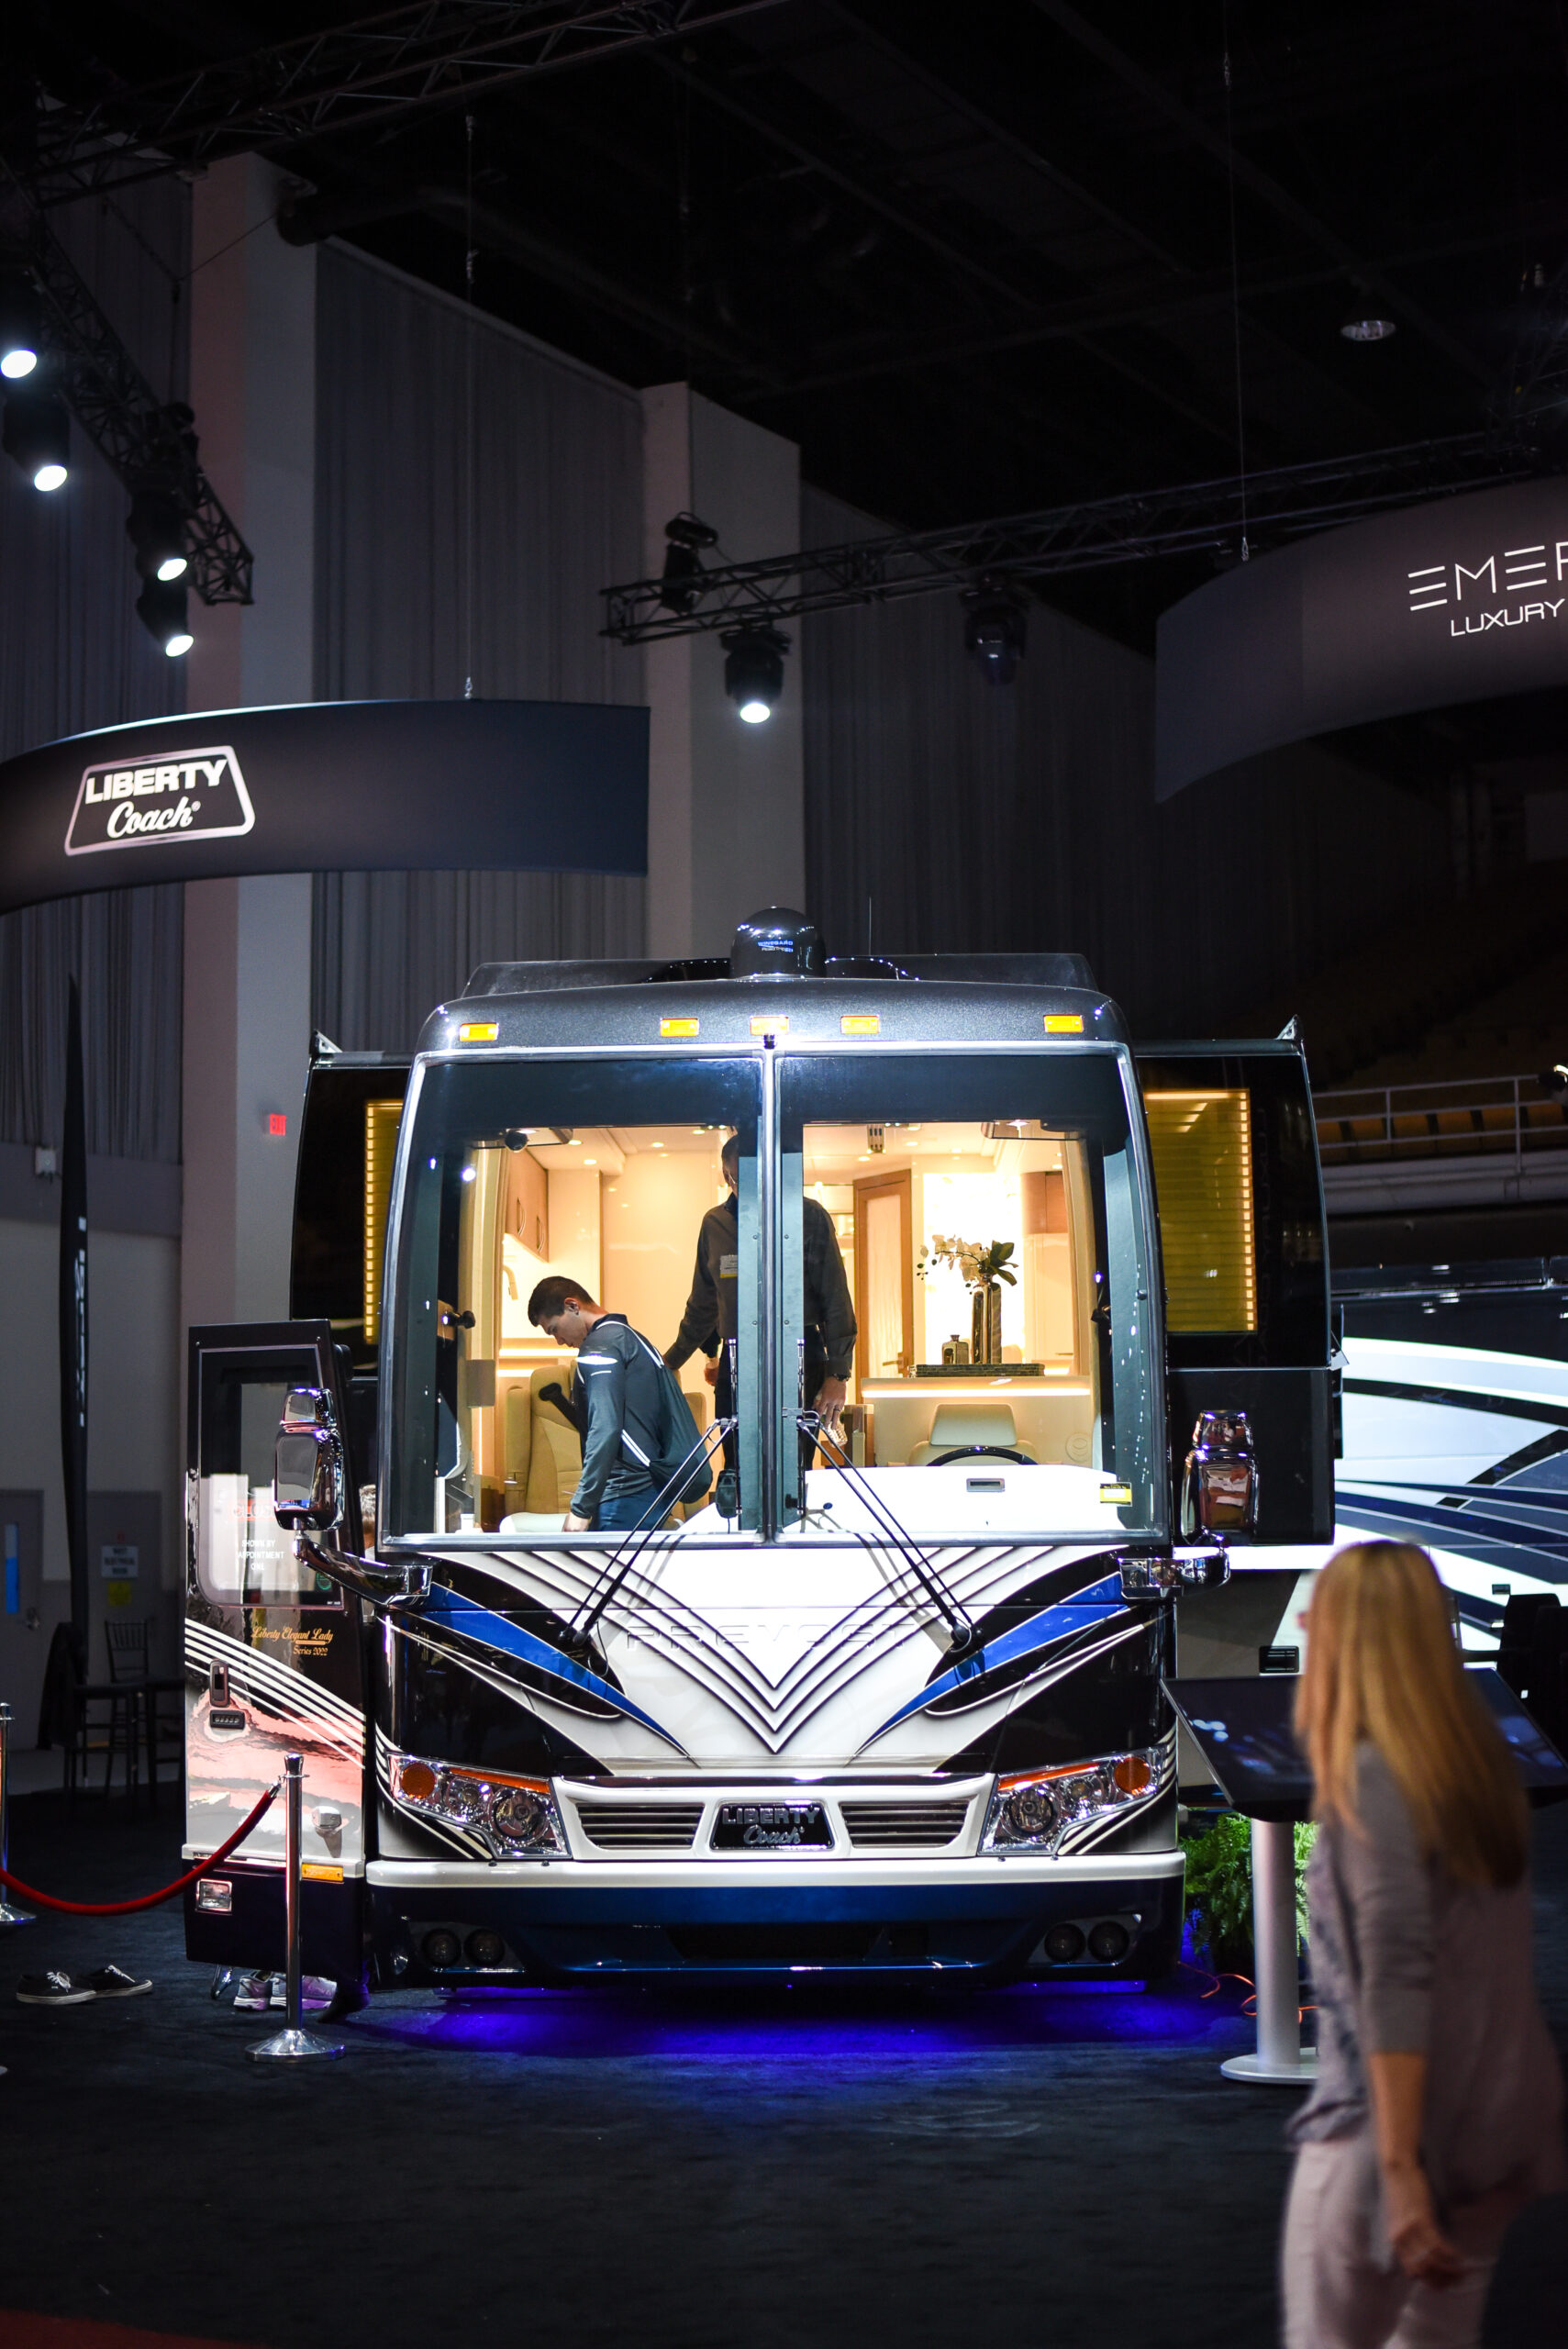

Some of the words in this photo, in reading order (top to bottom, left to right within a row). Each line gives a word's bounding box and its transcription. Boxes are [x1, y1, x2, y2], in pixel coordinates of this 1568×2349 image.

[1451, 598, 1565, 637] LUXURY
[85, 759, 228, 804] LIBERTY
[237, 1551, 284, 1559] APPOINTMENT
[250, 1625, 280, 1642] Liberty
[282, 1626, 310, 1642] Elegant
[311, 1628, 334, 1643] Lady
[626, 1622, 916, 1651] PREVOST
[293, 1645, 312, 1654] Series
[722, 1808, 821, 1824] LIBERTY
